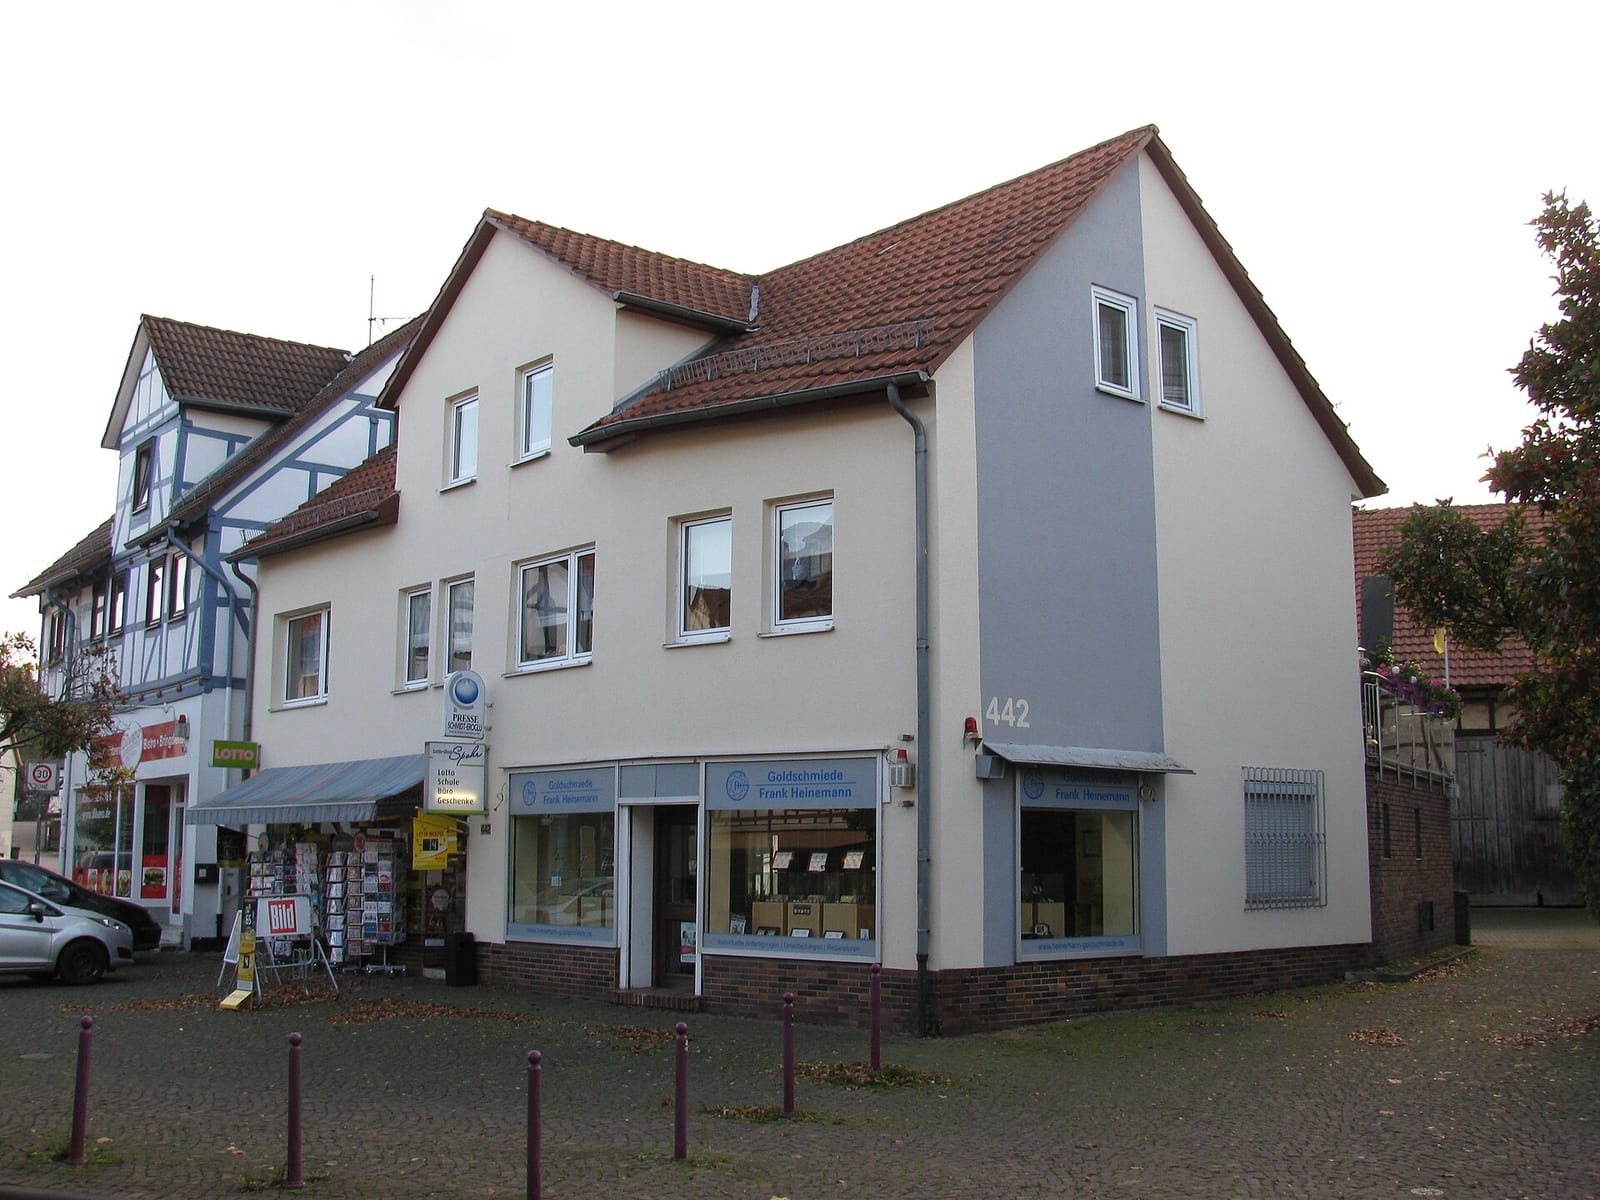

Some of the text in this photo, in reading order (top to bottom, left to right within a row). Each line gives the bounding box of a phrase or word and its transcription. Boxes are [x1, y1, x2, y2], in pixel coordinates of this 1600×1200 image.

[986, 696, 1030, 728] 442
[452, 713, 480, 724] PRESSE
[215, 748, 254, 761] LOTTO
[36, 769, 49, 779] 30
[437, 768, 456, 776] Lotto
[767, 769, 844, 782] Goldschmiede
[437, 778, 460, 786] Schule
[548, 780, 593, 790] Goldschmiede
[437, 787, 454, 795] Büro
[759, 786, 852, 799] Frank Heinemann
[1055, 787, 1130, 802] Frank Heinemann
[437, 796, 475, 806] Geschenke
[543, 793, 599, 805] Frank Heinemann
[269, 903, 295, 930] Bild
